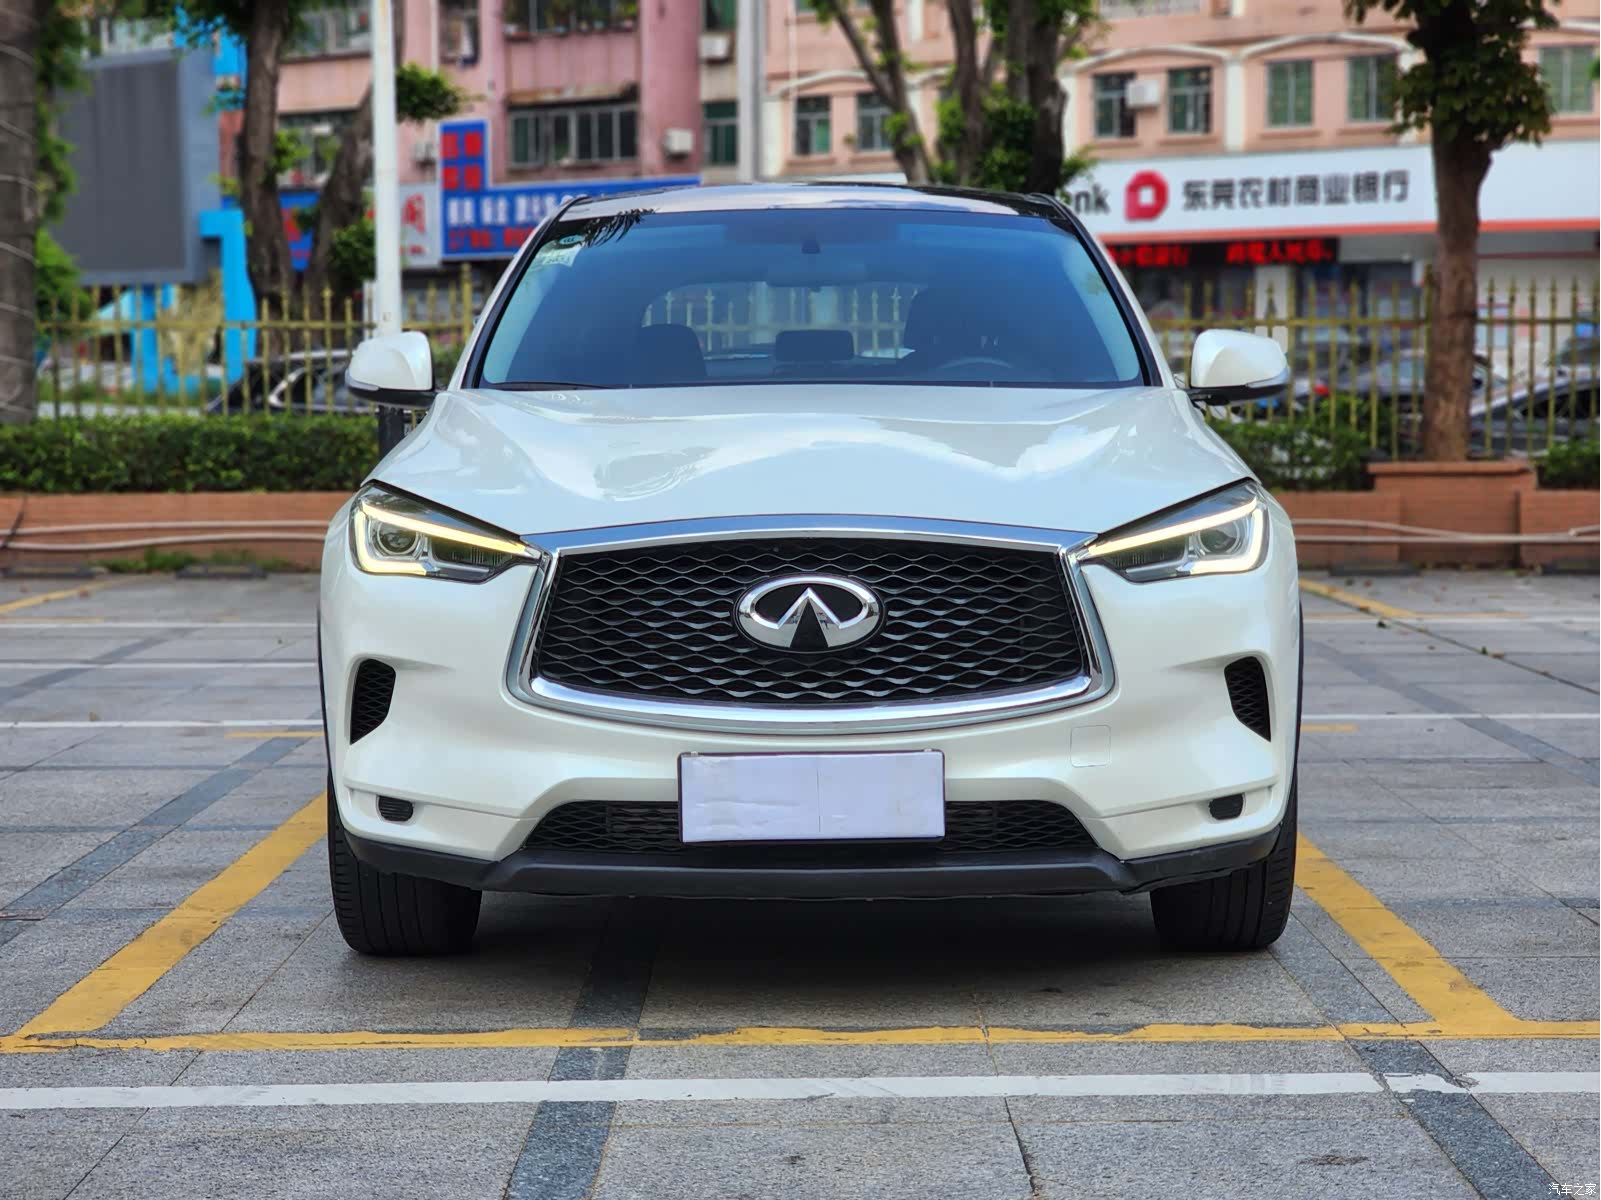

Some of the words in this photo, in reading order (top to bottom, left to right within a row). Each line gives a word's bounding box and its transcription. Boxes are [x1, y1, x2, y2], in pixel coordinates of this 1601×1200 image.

[1182, 169, 1410, 211] 东莞农村商业银行
